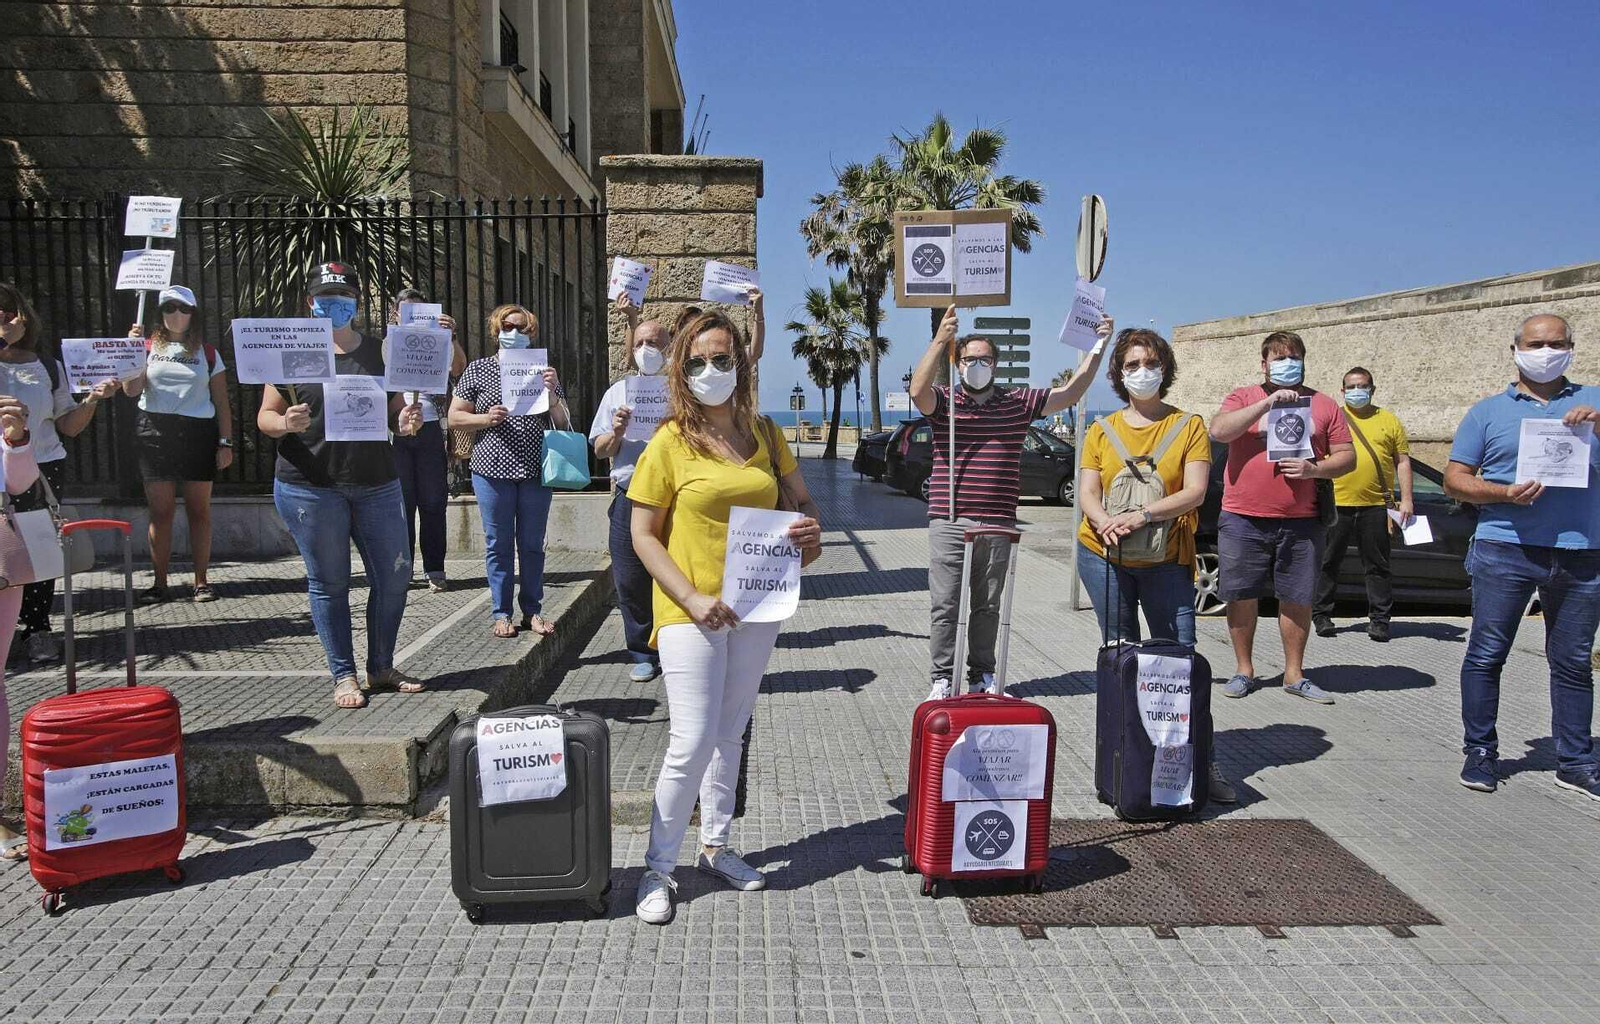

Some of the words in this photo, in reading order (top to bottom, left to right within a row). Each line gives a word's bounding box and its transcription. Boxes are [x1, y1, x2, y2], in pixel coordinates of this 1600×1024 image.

[959, 245, 1004, 254] AGENCIAS
[321, 264, 329, 275] I
[321, 274, 346, 284] MK
[92, 341, 128, 349] ¡BASTA
[732, 530, 774, 538] SALVEMOS
[731, 542, 800, 558] AGENCIAS
[1139, 682, 1191, 695] AGENCIAS
[482, 720, 560, 736] AGENCIAS
[90, 770, 121, 780] ESTAS
[123, 763, 170, 775] MALETAS,
[966, 774, 1023, 783] COMENZAR!!
[87, 787, 121, 799] ¡ESTÁN
[124, 780, 174, 793] CARGADAS
[116, 799, 164, 812] SUEÑOS!
